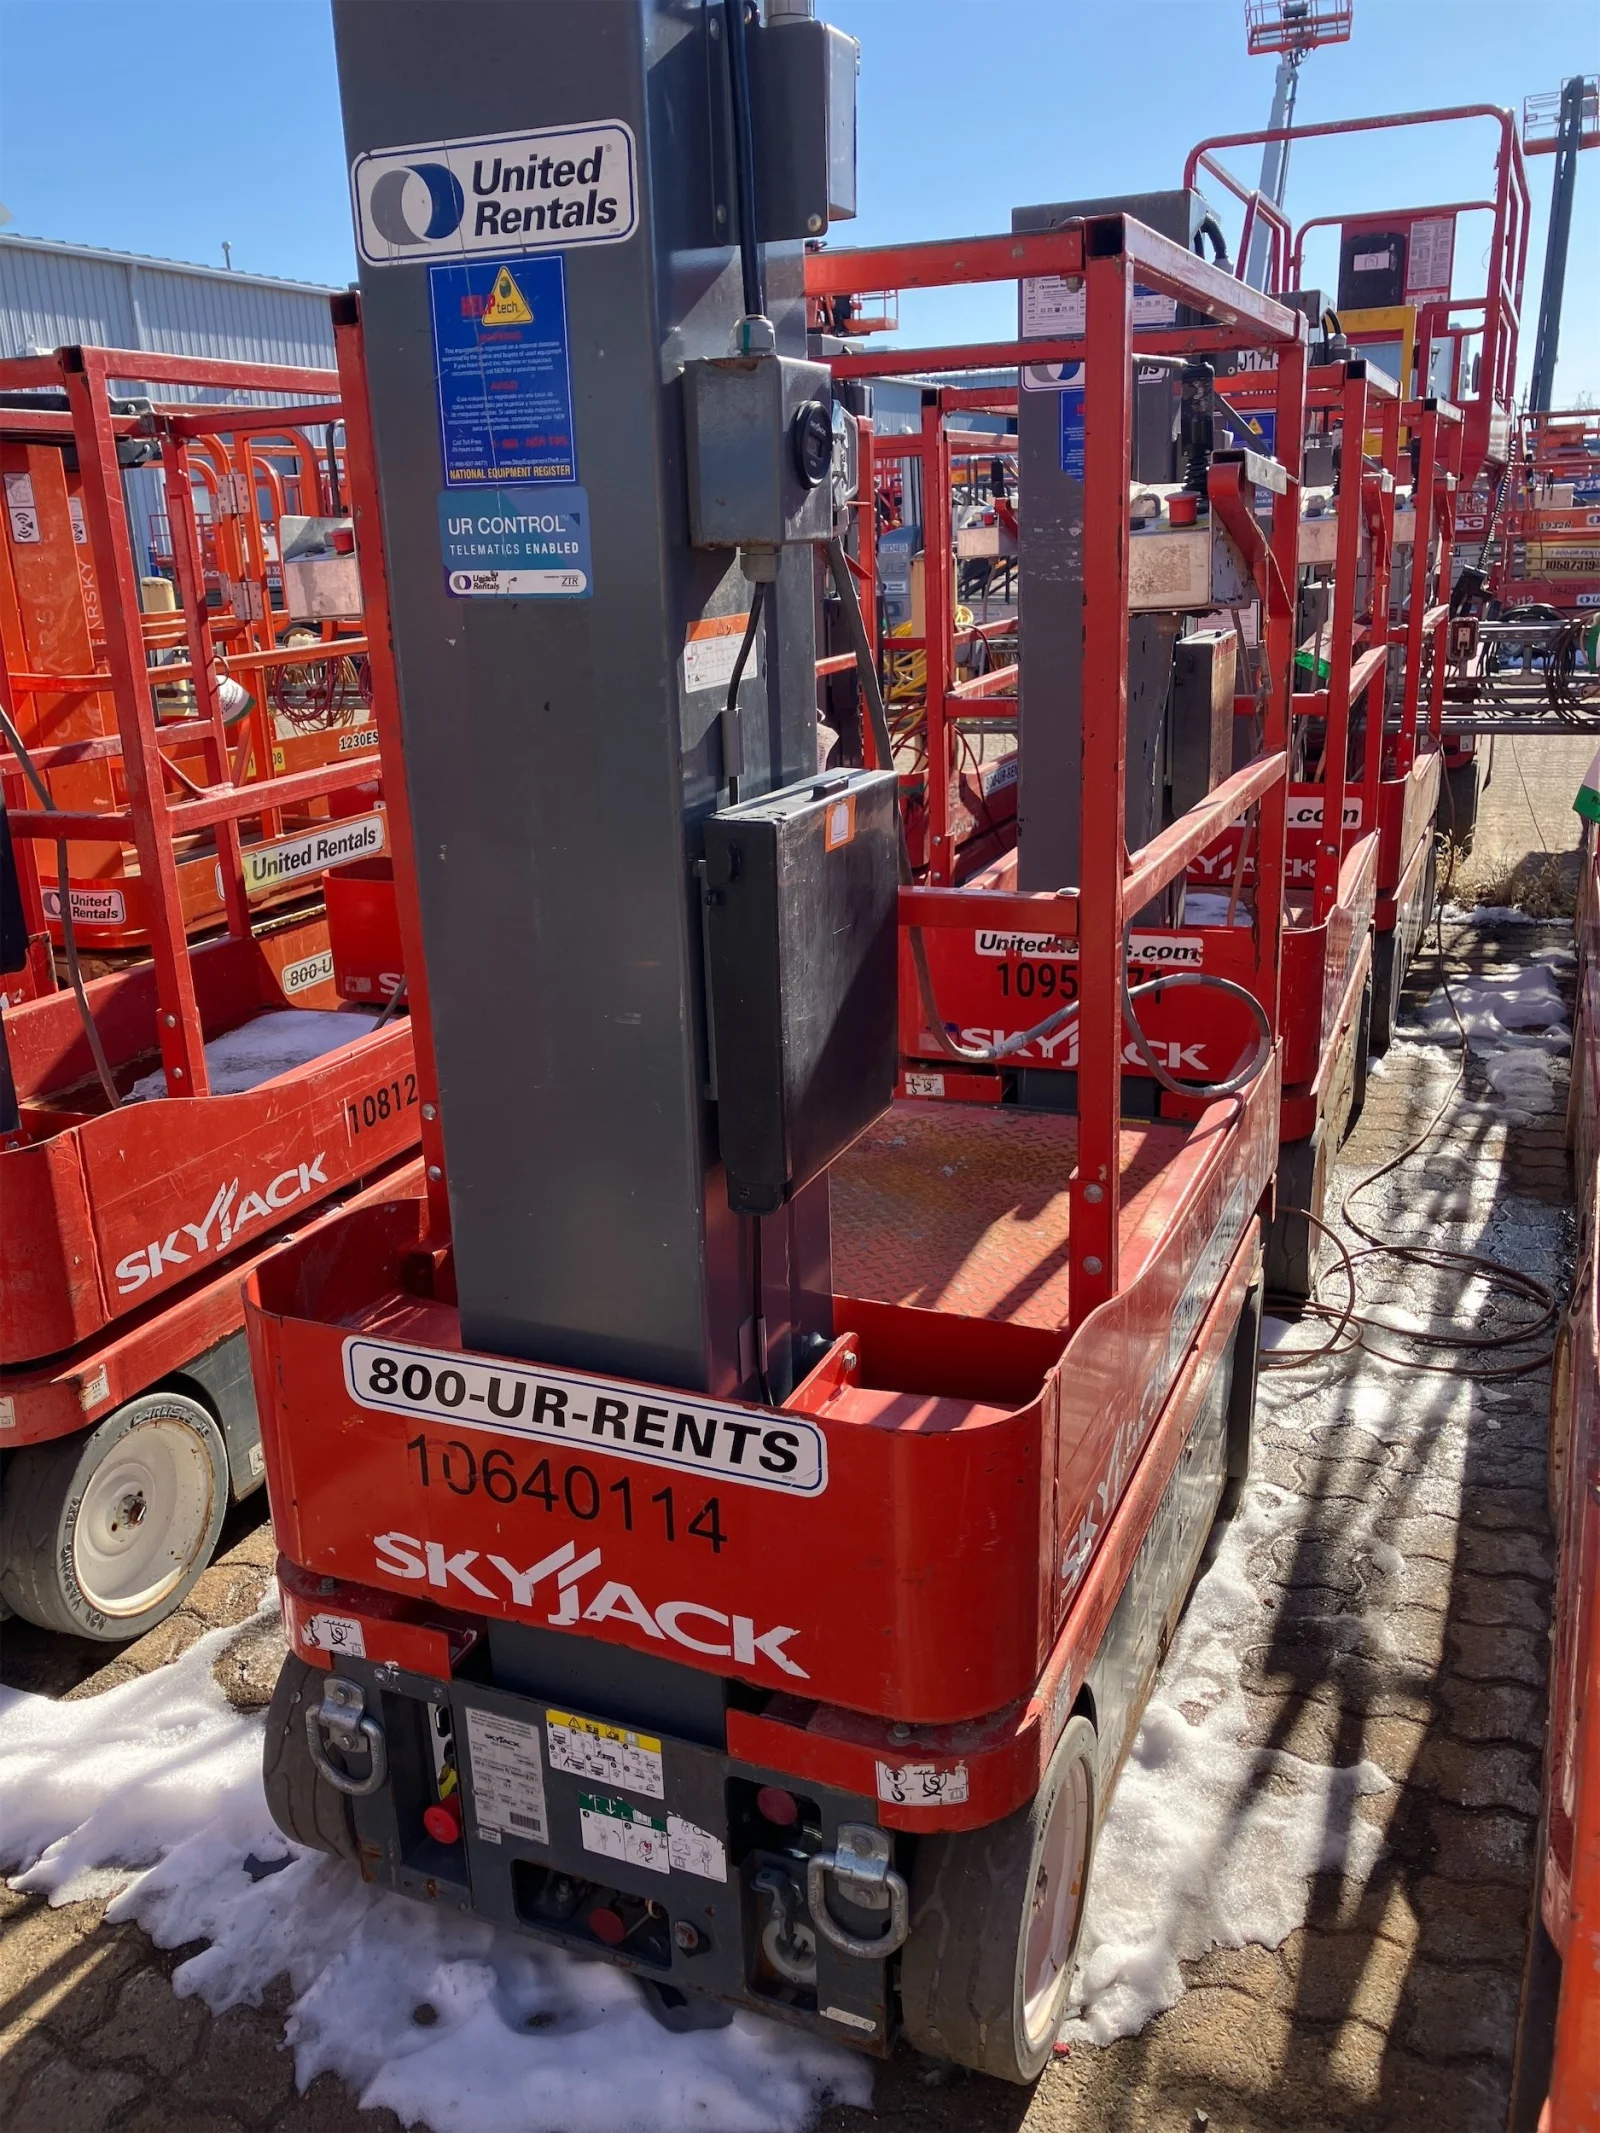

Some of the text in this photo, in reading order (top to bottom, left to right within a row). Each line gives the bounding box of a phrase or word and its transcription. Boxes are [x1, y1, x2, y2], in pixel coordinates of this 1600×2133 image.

[472, 146, 603, 197] United
[475, 189, 617, 236] Rentals
[497, 302, 518, 314] tech
[449, 464, 571, 480] NATIONAL EQUIPMENT REGISTER
[448, 515, 566, 535] UR CONTROL
[450, 541, 579, 556] TELEMATICS ENABLED
[473, 574, 496, 583] United
[473, 582, 500, 591] Rentals
[339, 731, 379, 750] 1230ES
[252, 826, 376, 881] United Rentals
[71, 894, 112, 906] United
[72, 906, 119, 919] Rentals
[115, 1151, 328, 1294] SKYJACK
[368, 1357, 799, 1473] 800-UR-RENTS
[406, 1433, 728, 1554] 10640114
[373, 1531, 811, 1680] SKYJACK
